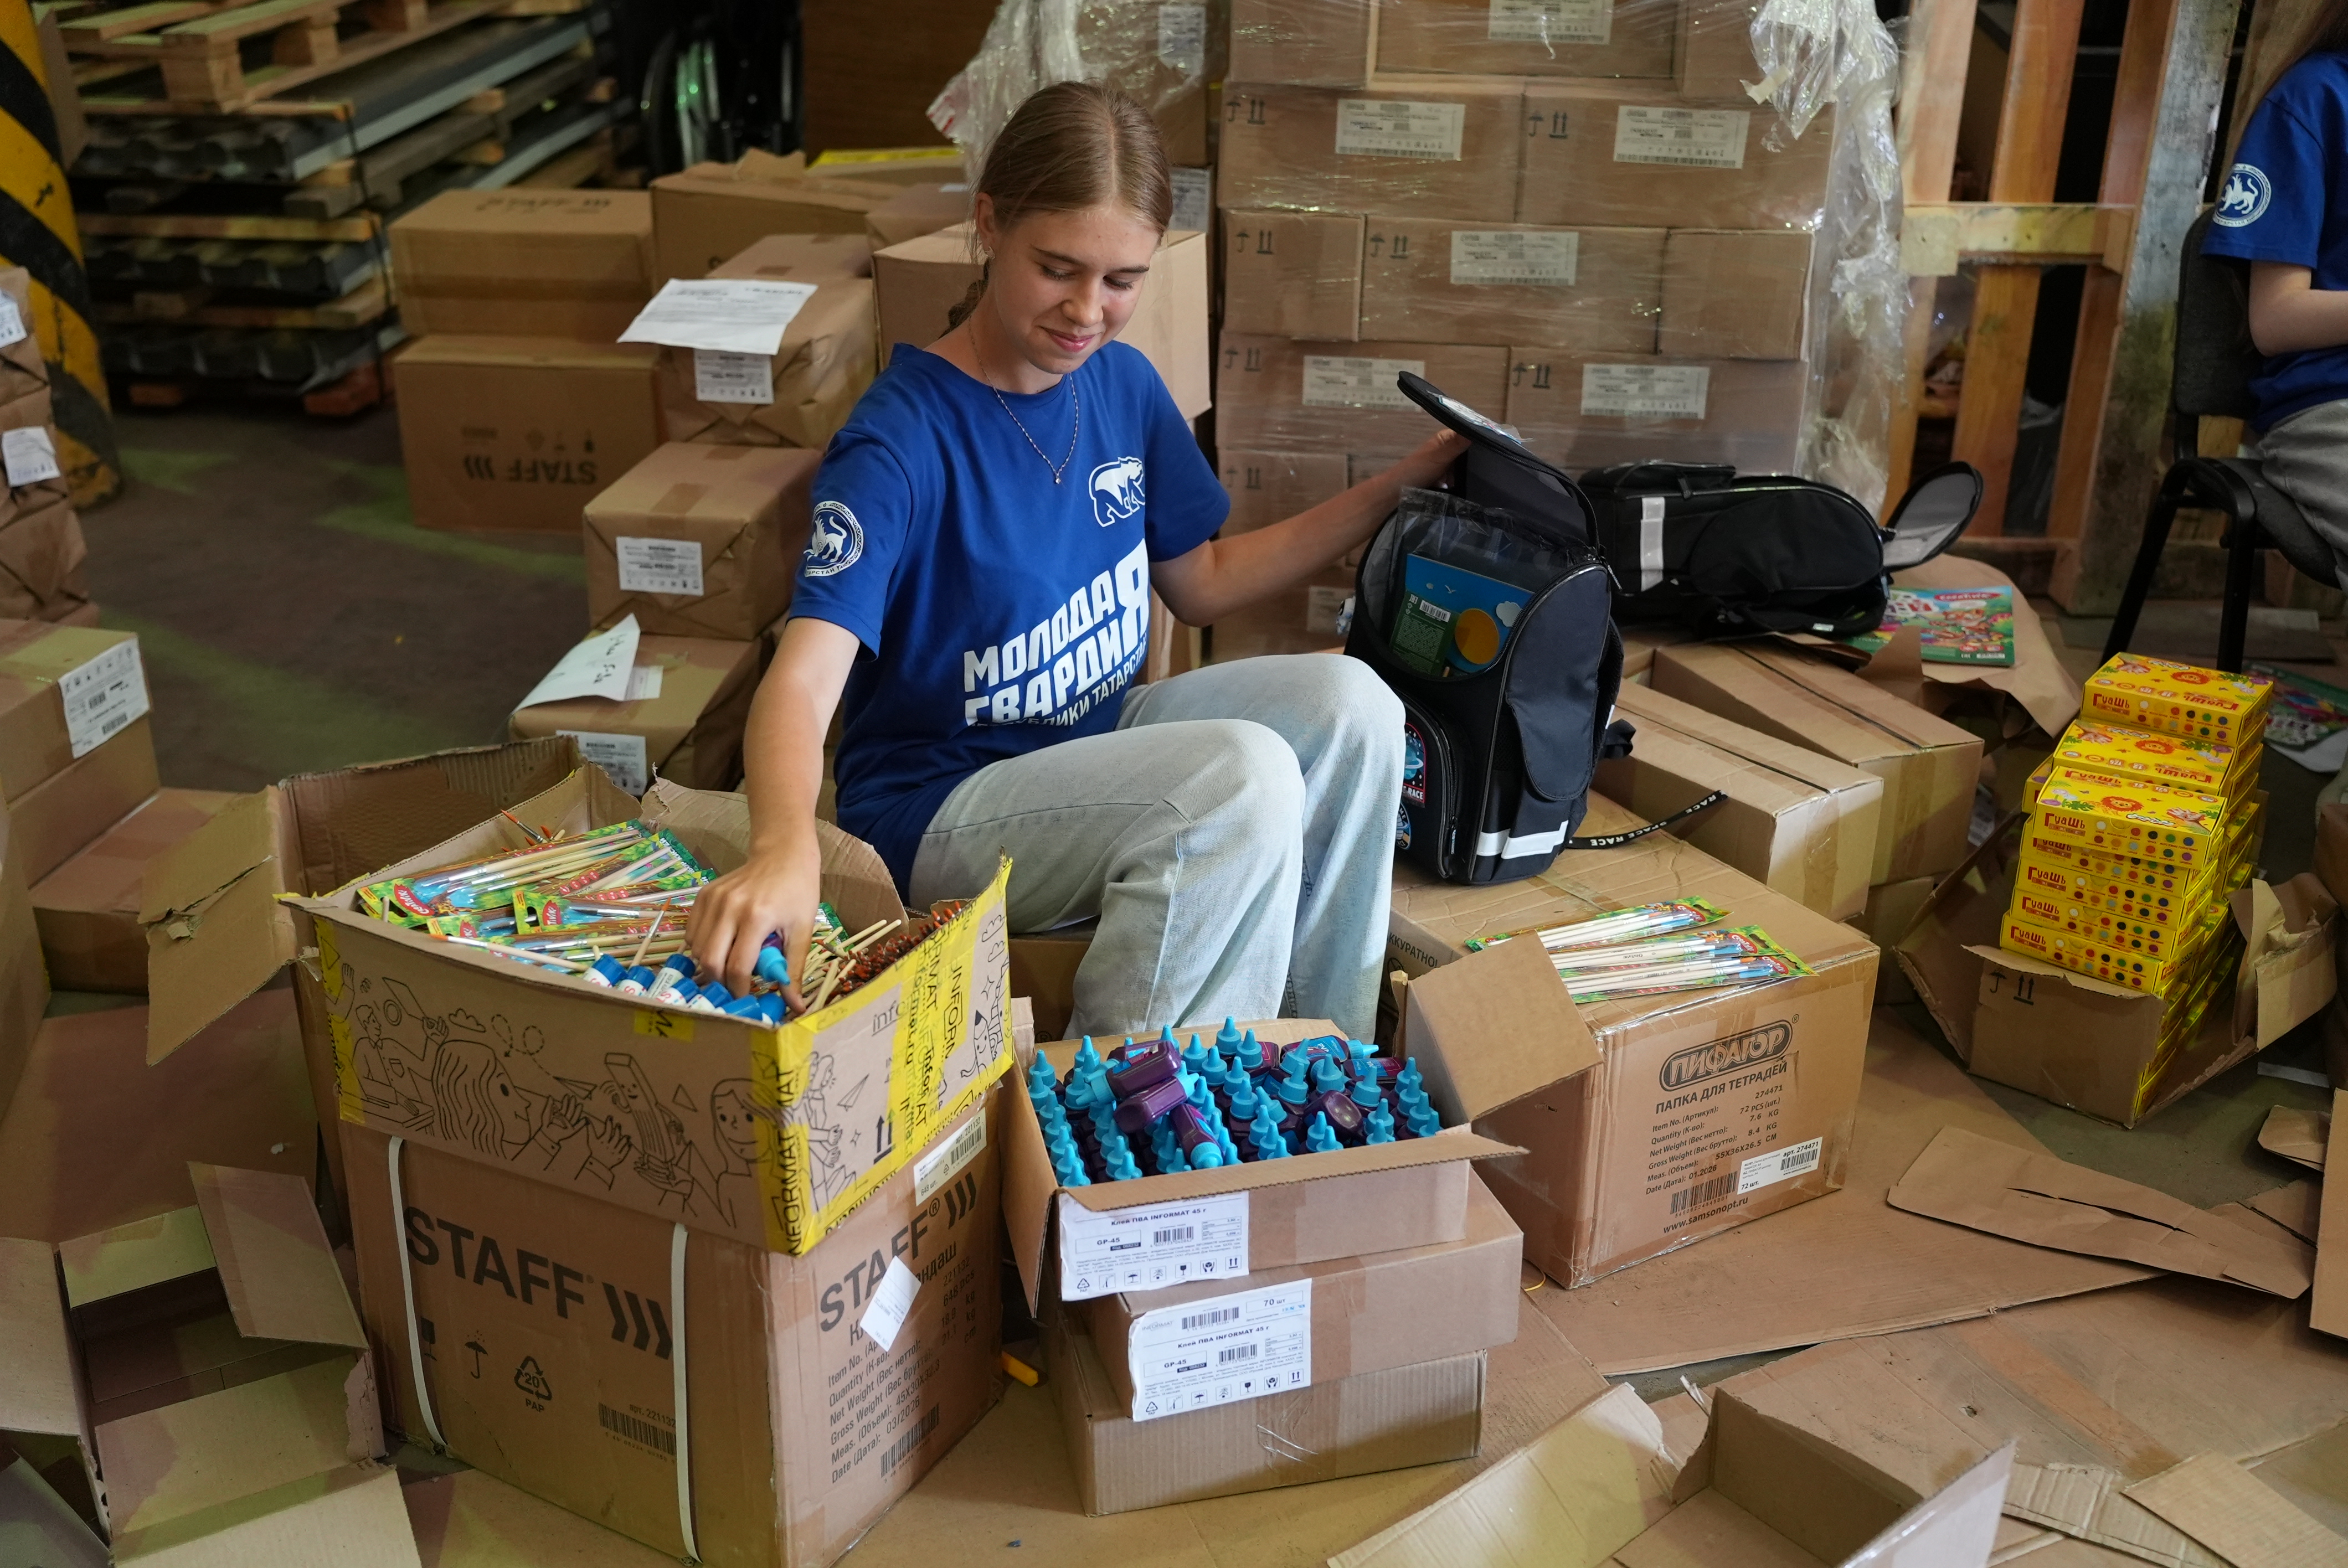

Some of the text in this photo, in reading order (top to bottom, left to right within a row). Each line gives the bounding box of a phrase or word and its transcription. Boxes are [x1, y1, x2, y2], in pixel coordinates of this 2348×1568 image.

[507, 458, 598, 485] STAFF
[2093, 693, 2130, 709] Гуашь
[1408, 789, 1423, 800] RACE
[1685, 795, 1717, 814] RACE
[2044, 812, 2086, 829] Гуашь
[1590, 836, 1624, 846] RACE
[2027, 866, 2066, 884] Гуашь
[2022, 896, 2059, 915] Гуашь
[2010, 925, 2046, 946] Гуашь
[1389, 932, 1438, 968] ККУРАТНО!
[1669, 1026, 1786, 1086] ПИФАГОР
[1655, 1060, 1788, 1114] ПАПКА ДЛЯ ТЕТРАДЕЙ
[1652, 1085, 1783, 1133] Item No. (Артикул): 274471
[965, 1116, 981, 1137] 221132
[1650, 1108, 1780, 1158] Net Weight (Вес нетто): 7.6 KG
[1651, 1131, 1681, 1146] Quantity
[1739, 1105, 1749, 1115] 72
[1647, 1172, 1667, 1183] Meas.
[1765, 1133, 1777, 1143] CM
[1649, 1122, 1778, 1170] Gross Weight (Вес брутто): 8.4 KG
[1796, 1141, 1819, 1153] 274471
[1645, 1164, 1717, 1195] Date (Дата): 01.2026
[1749, 1180, 1759, 1188] шт.
[777, 1132, 802, 1256] NFORMAT
[1132, 1215, 1149, 1224] ПВА
[1150, 1209, 1190, 1220] INFORMAT
[1663, 1196, 1749, 1234] www.samsonopt.ru
[1096, 1237, 1120, 1246] GP-45
[403, 1205, 585, 1319] STAFF
[820, 1209, 928, 1333] STAFF
[1263, 1298, 1275, 1307] 70
[1216, 1329, 1253, 1341] INFORMAT
[828, 1366, 847, 1389] Item
[848, 1354, 863, 1371] No.
[1163, 1360, 1187, 1369] GP-45
[524, 1372, 540, 1389] 20
[830, 1371, 864, 1407] Quantity
[525, 1398, 544, 1412] PAP
[830, 1406, 845, 1427] Net
[847, 1380, 875, 1411] Weight
[877, 1365, 893, 1388] (Вес
[629, 1404, 645, 1416] арт.
[831, 1419, 854, 1446] Gross
[856, 1392, 883, 1423] Weight
[885, 1376, 902, 1399] (Вес
[832, 1394, 921, 1484] Date (Дата): 03/2026
[832, 1439, 856, 1466] Meas.
